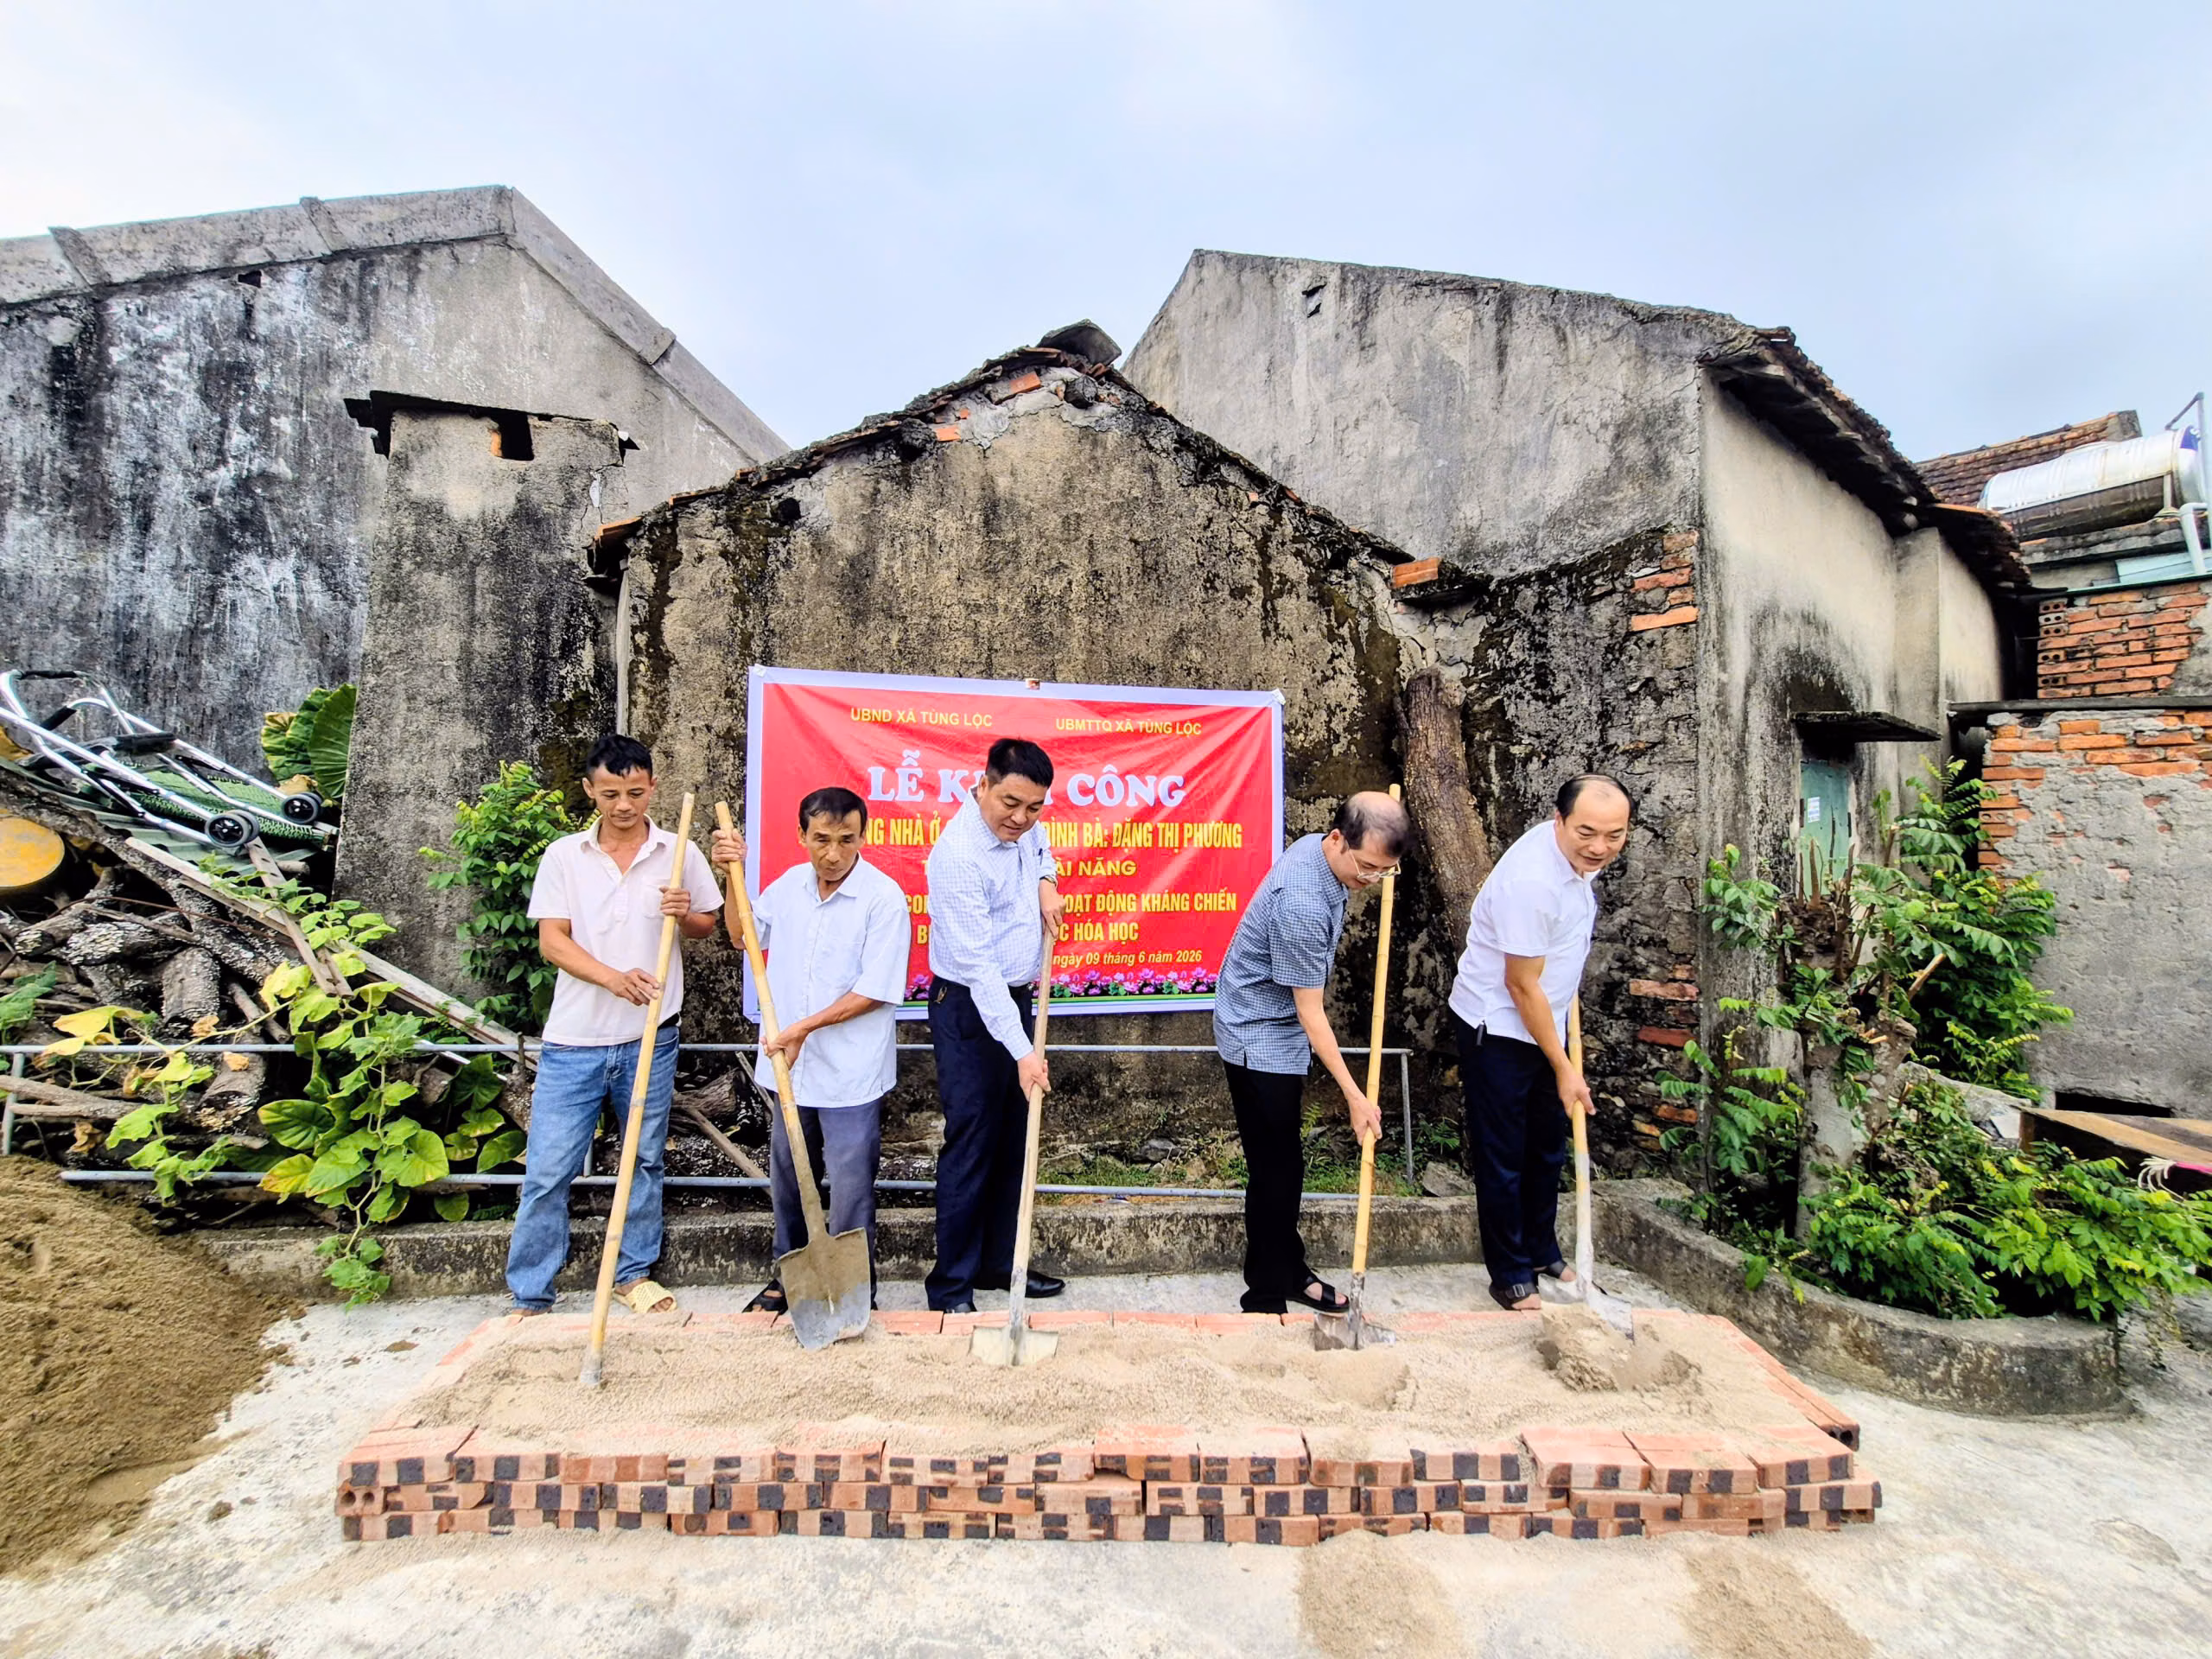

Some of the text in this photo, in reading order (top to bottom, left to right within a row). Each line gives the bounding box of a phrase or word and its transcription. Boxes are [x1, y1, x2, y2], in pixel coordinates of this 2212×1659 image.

[851, 707, 993, 728] UBND XÃ TÙNG LỘC
[1056, 718, 1202, 737] UBMTTQ XÃ TÙNG LỘC
[868, 749, 925, 802] LỄ
[1067, 764, 1186, 807] CÔNG
[866, 817, 885, 845] NG
[889, 813, 925, 845] NHÀ
[930, 810, 941, 846] Ở
[1083, 817, 1109, 848] BÀ:
[1112, 817, 1154, 853] ĐẶNG
[1157, 822, 1179, 853] THỊ
[1183, 821, 1243, 849] PHƯƠNG
[1055, 856, 1137, 877] ÀI NĂNG
[1065, 893, 1093, 918] OẠT
[1096, 890, 1137, 917] ĐỘNG
[1141, 889, 1190, 912] KHÁNG
[1194, 887, 1237, 912] CHIẾN
[1073, 919, 1104, 941] HÓA
[1109, 922, 1140, 945] HỌC
[1052, 950, 1203, 969] ngày 09 tháng 6 năm 2026
